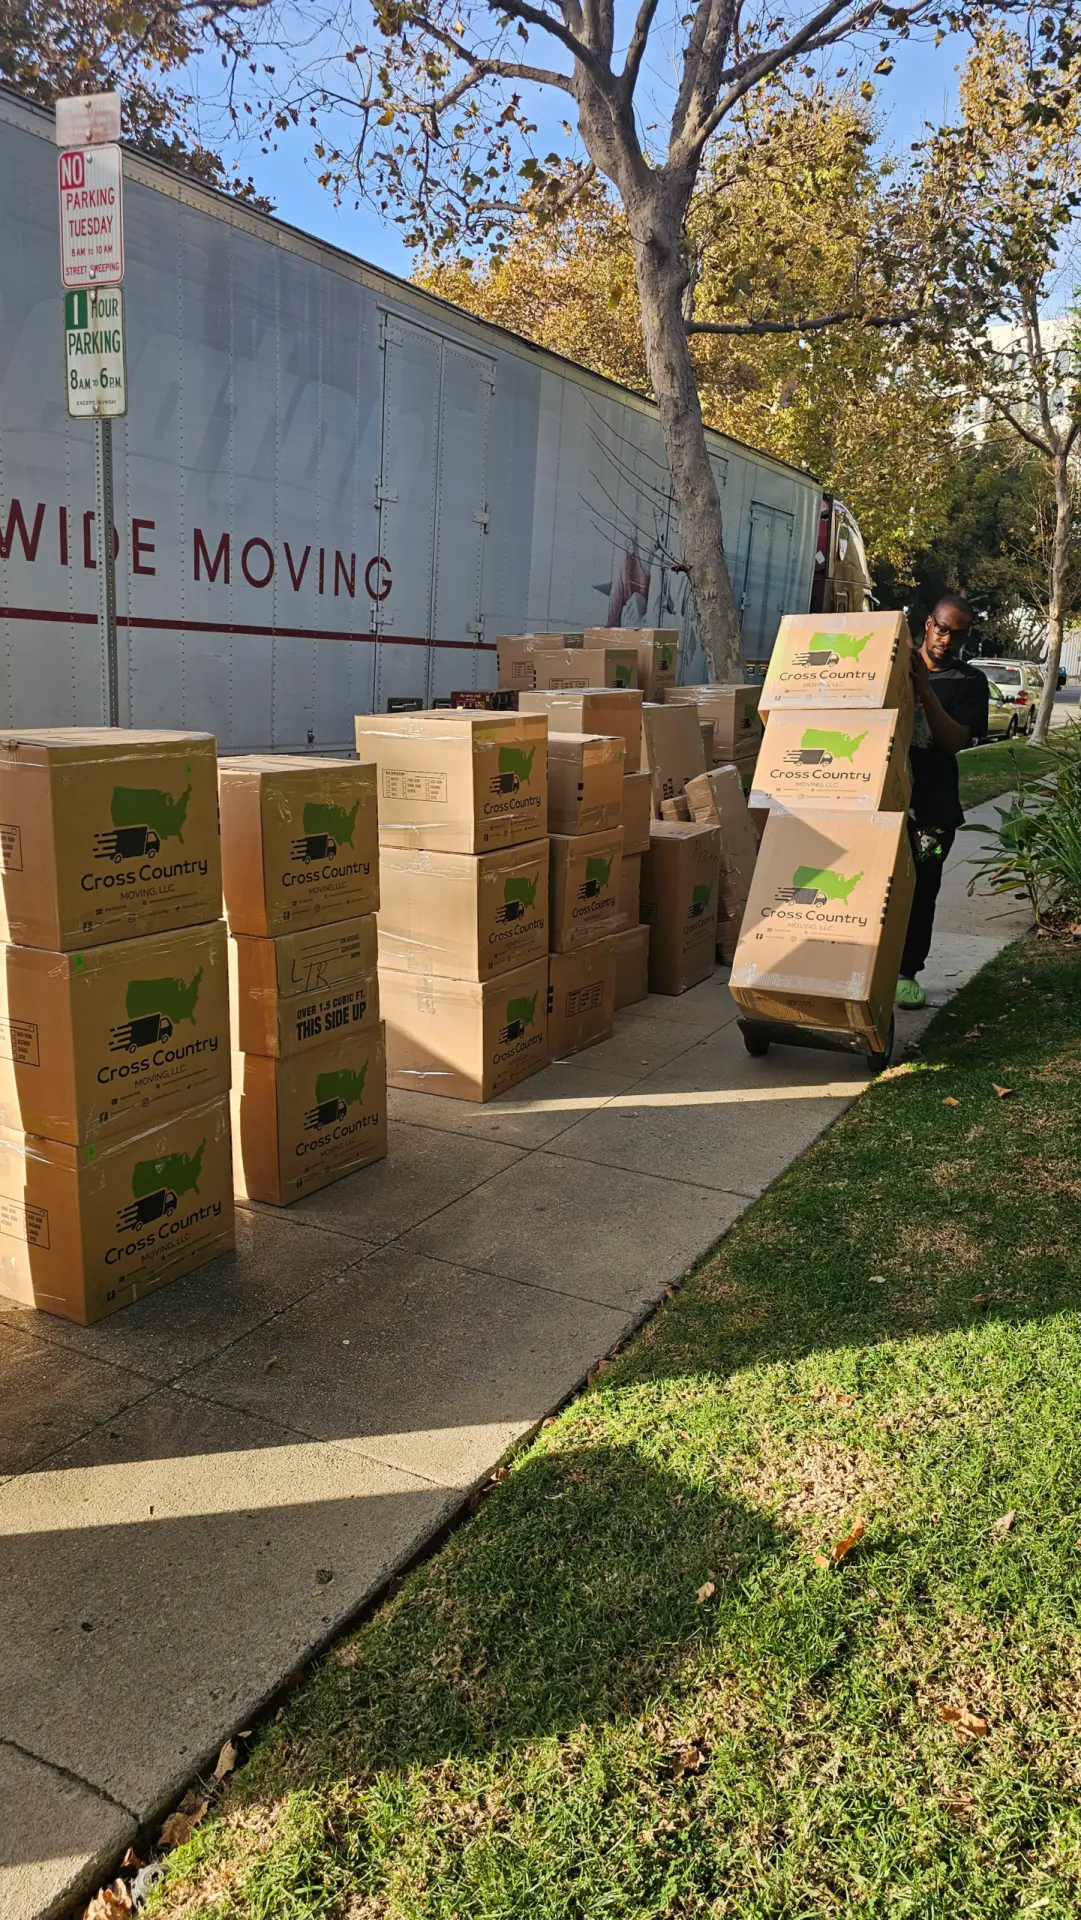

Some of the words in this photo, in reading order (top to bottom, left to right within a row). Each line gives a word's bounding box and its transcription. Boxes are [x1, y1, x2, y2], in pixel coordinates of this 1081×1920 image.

[61, 155, 83, 187] NO
[66, 187, 115, 210] PARKING
[69, 215, 113, 237] TUESDAY
[71, 248, 75, 257] 8
[76, 248, 85, 257] AM
[96, 246, 102, 254] 10
[103, 244, 113, 253] AM
[66, 265, 87, 276] STREET
[90, 262, 120, 273] SWEEPING
[73, 294, 78, 325] 1
[91, 298, 118, 318] HOUR
[68, 329, 120, 356] PARKING
[0, 499, 156, 576] WIDE
[193, 528, 393, 601] MOVING
[780, 672, 817, 680] Cross
[820, 670, 876, 681] Country
[770, 769, 809, 778] Cross
[812, 769, 871, 781] Country
[484, 802, 509, 815] Cross
[510, 796, 541, 809] Country
[81, 872, 136, 891] Cross
[139, 860, 208, 881] Country
[282, 870, 320, 887] Cross
[322, 862, 370, 880] Country
[120, 887, 157, 900] MOVING,
[572, 905, 590, 918] Cross
[591, 897, 615, 911] Country
[761, 907, 802, 920] Cross
[805, 910, 868, 927] Country
[488, 929, 513, 944] Cross
[514, 918, 544, 935] Country
[297, 1005, 316, 1019] OVER
[319, 1000, 331, 1012] 1.5
[333, 993, 353, 1008] CUBIC
[356, 990, 365, 1001] FT.
[296, 1016, 322, 1041] THIS
[325, 1006, 349, 1031] SIDE
[353, 1001, 367, 1021] UP
[97, 1058, 150, 1084] Cross
[153, 1036, 218, 1066] Country
[493, 1048, 515, 1065] Cross
[516, 1033, 543, 1053] Country
[134, 1071, 170, 1088] MOVING,
[295, 1134, 331, 1156] Cross
[333, 1113, 379, 1140] Country
[104, 1233, 156, 1265] Cross
[158, 1200, 221, 1239] Country
[141, 1242, 175, 1262] MOVING,
